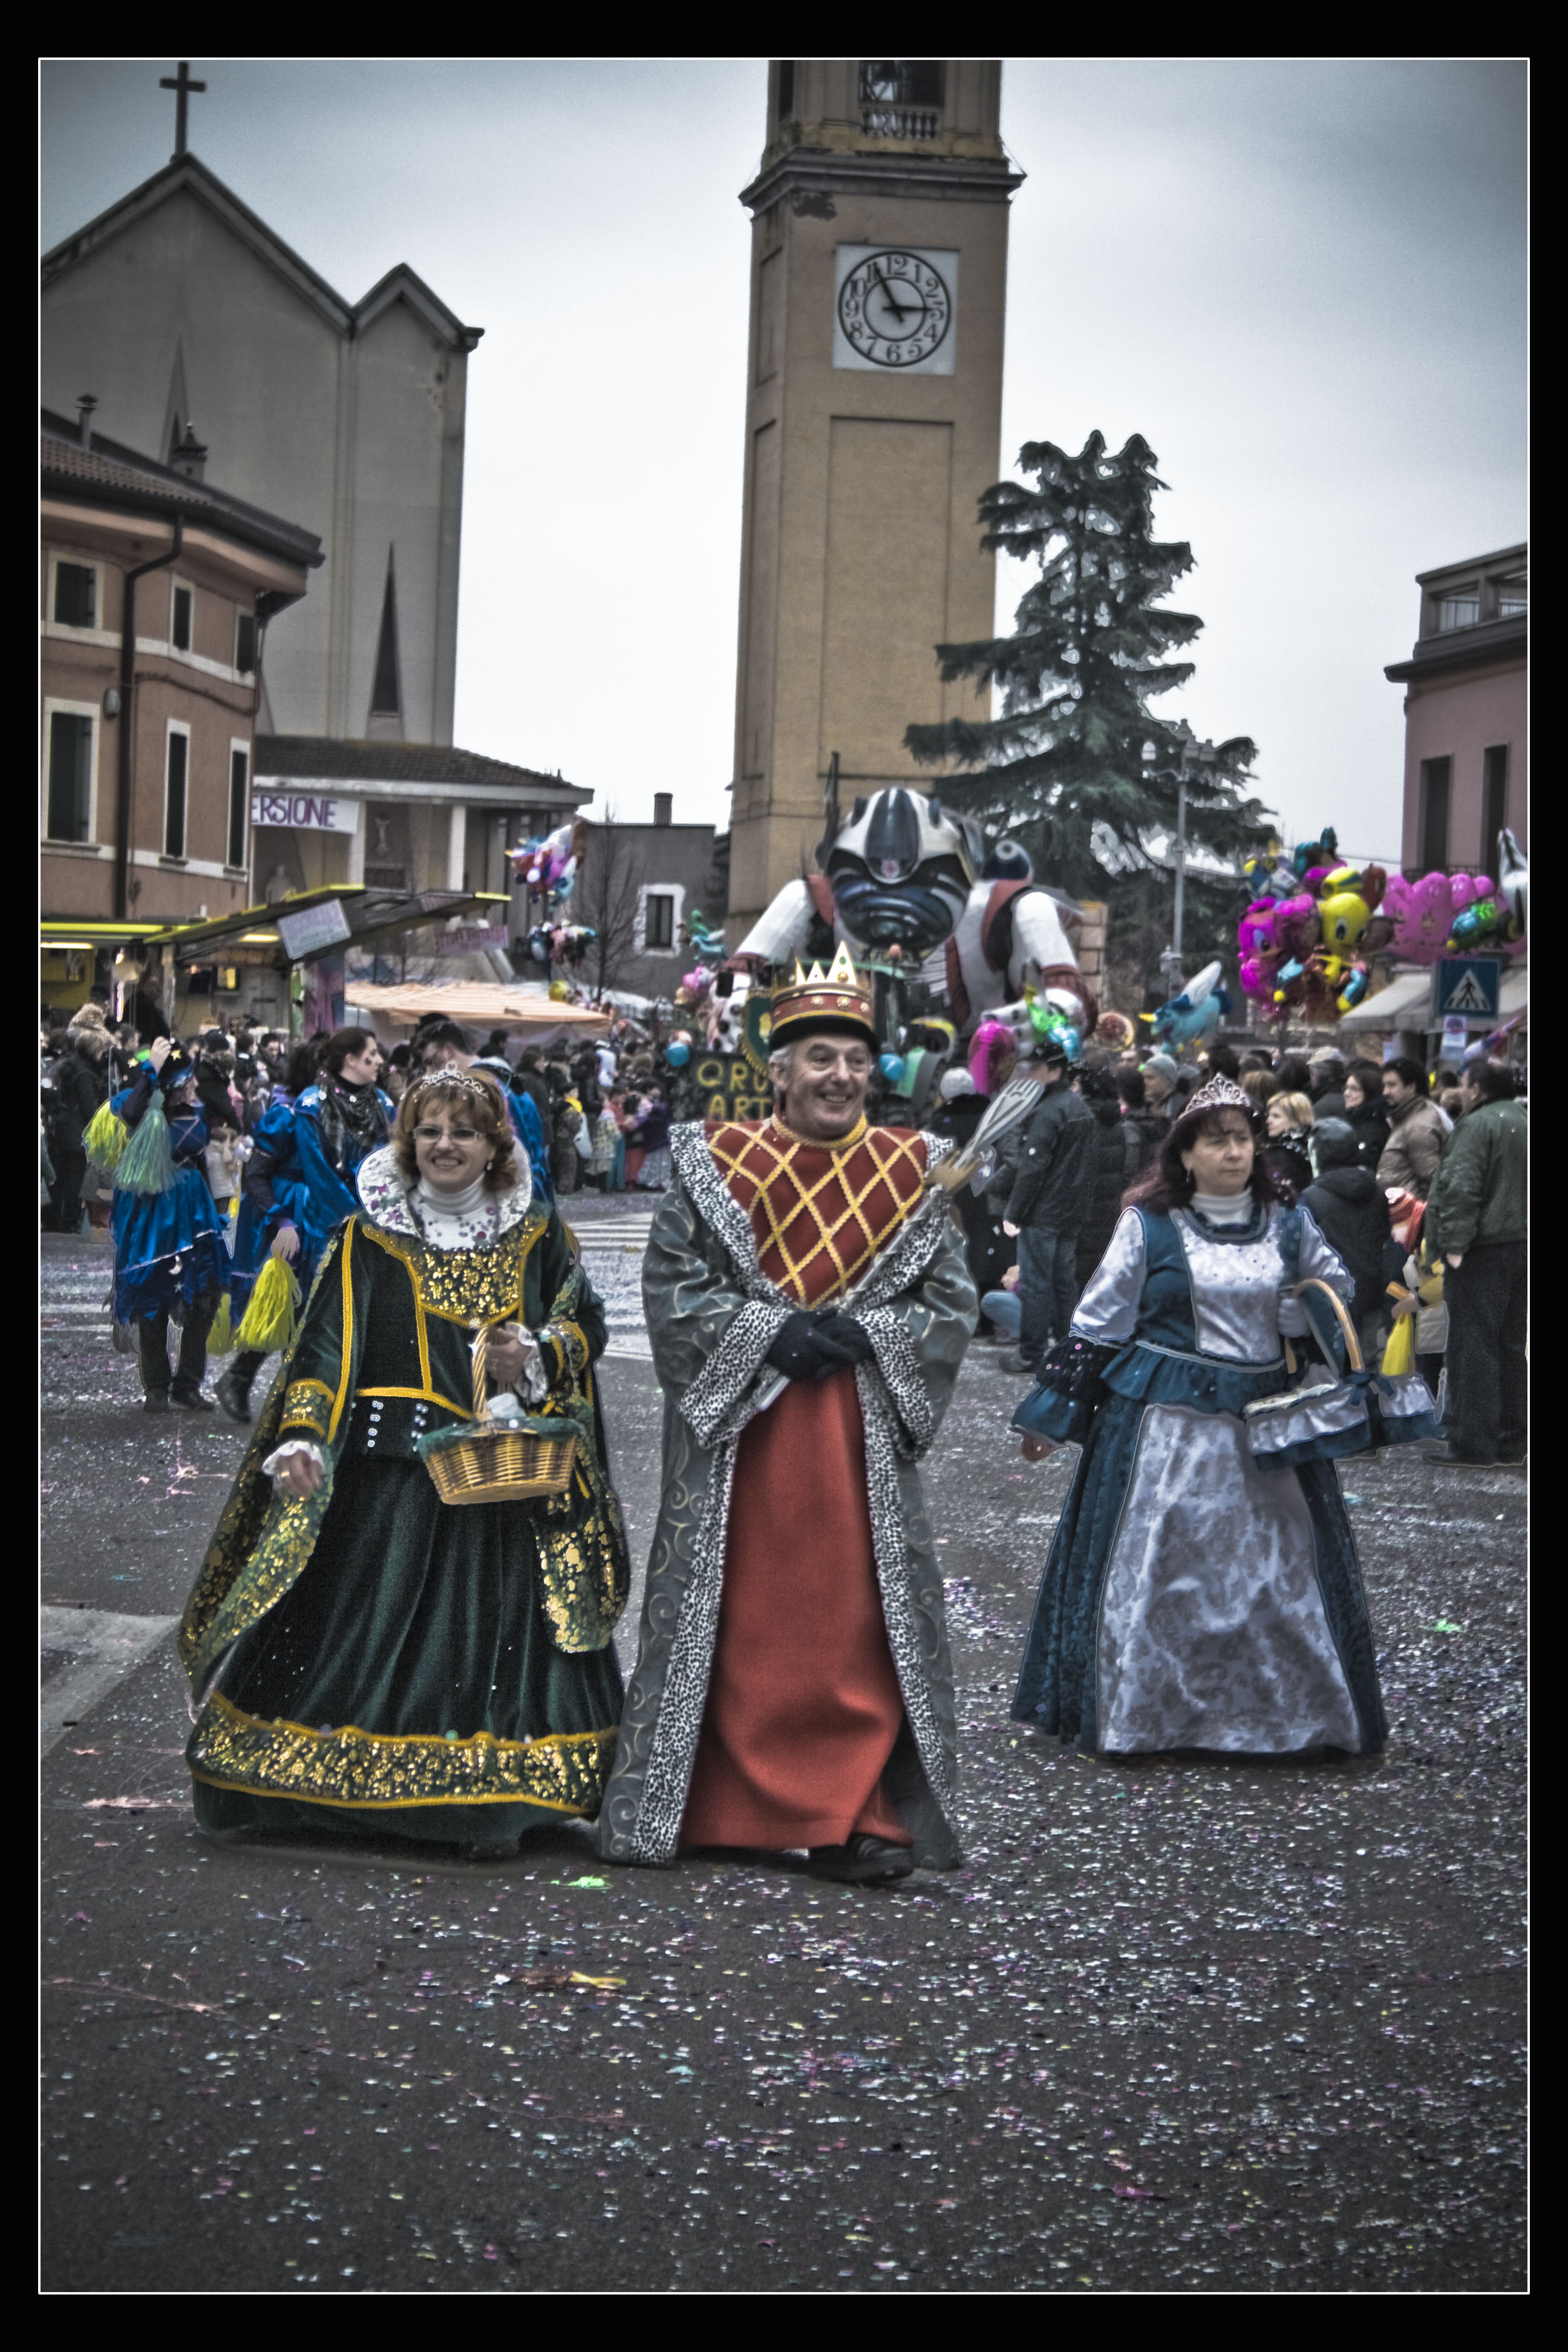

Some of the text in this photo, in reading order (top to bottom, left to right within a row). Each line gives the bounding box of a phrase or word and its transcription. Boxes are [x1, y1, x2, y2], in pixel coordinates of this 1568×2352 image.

[866, 261, 878, 283] 11
[886, 256, 907, 276] 12
[914, 263, 921, 283] 1
[849, 278, 866, 298] 10
[925, 278, 938, 298] 2
[845, 299, 858, 318] 9
[929, 301, 944, 321] 3
[849, 321, 863, 340] 8
[924, 323, 937, 343] 4
[866, 335, 877, 356] 7
[886, 344, 900, 363] 6
[909, 338, 923, 359] 5
